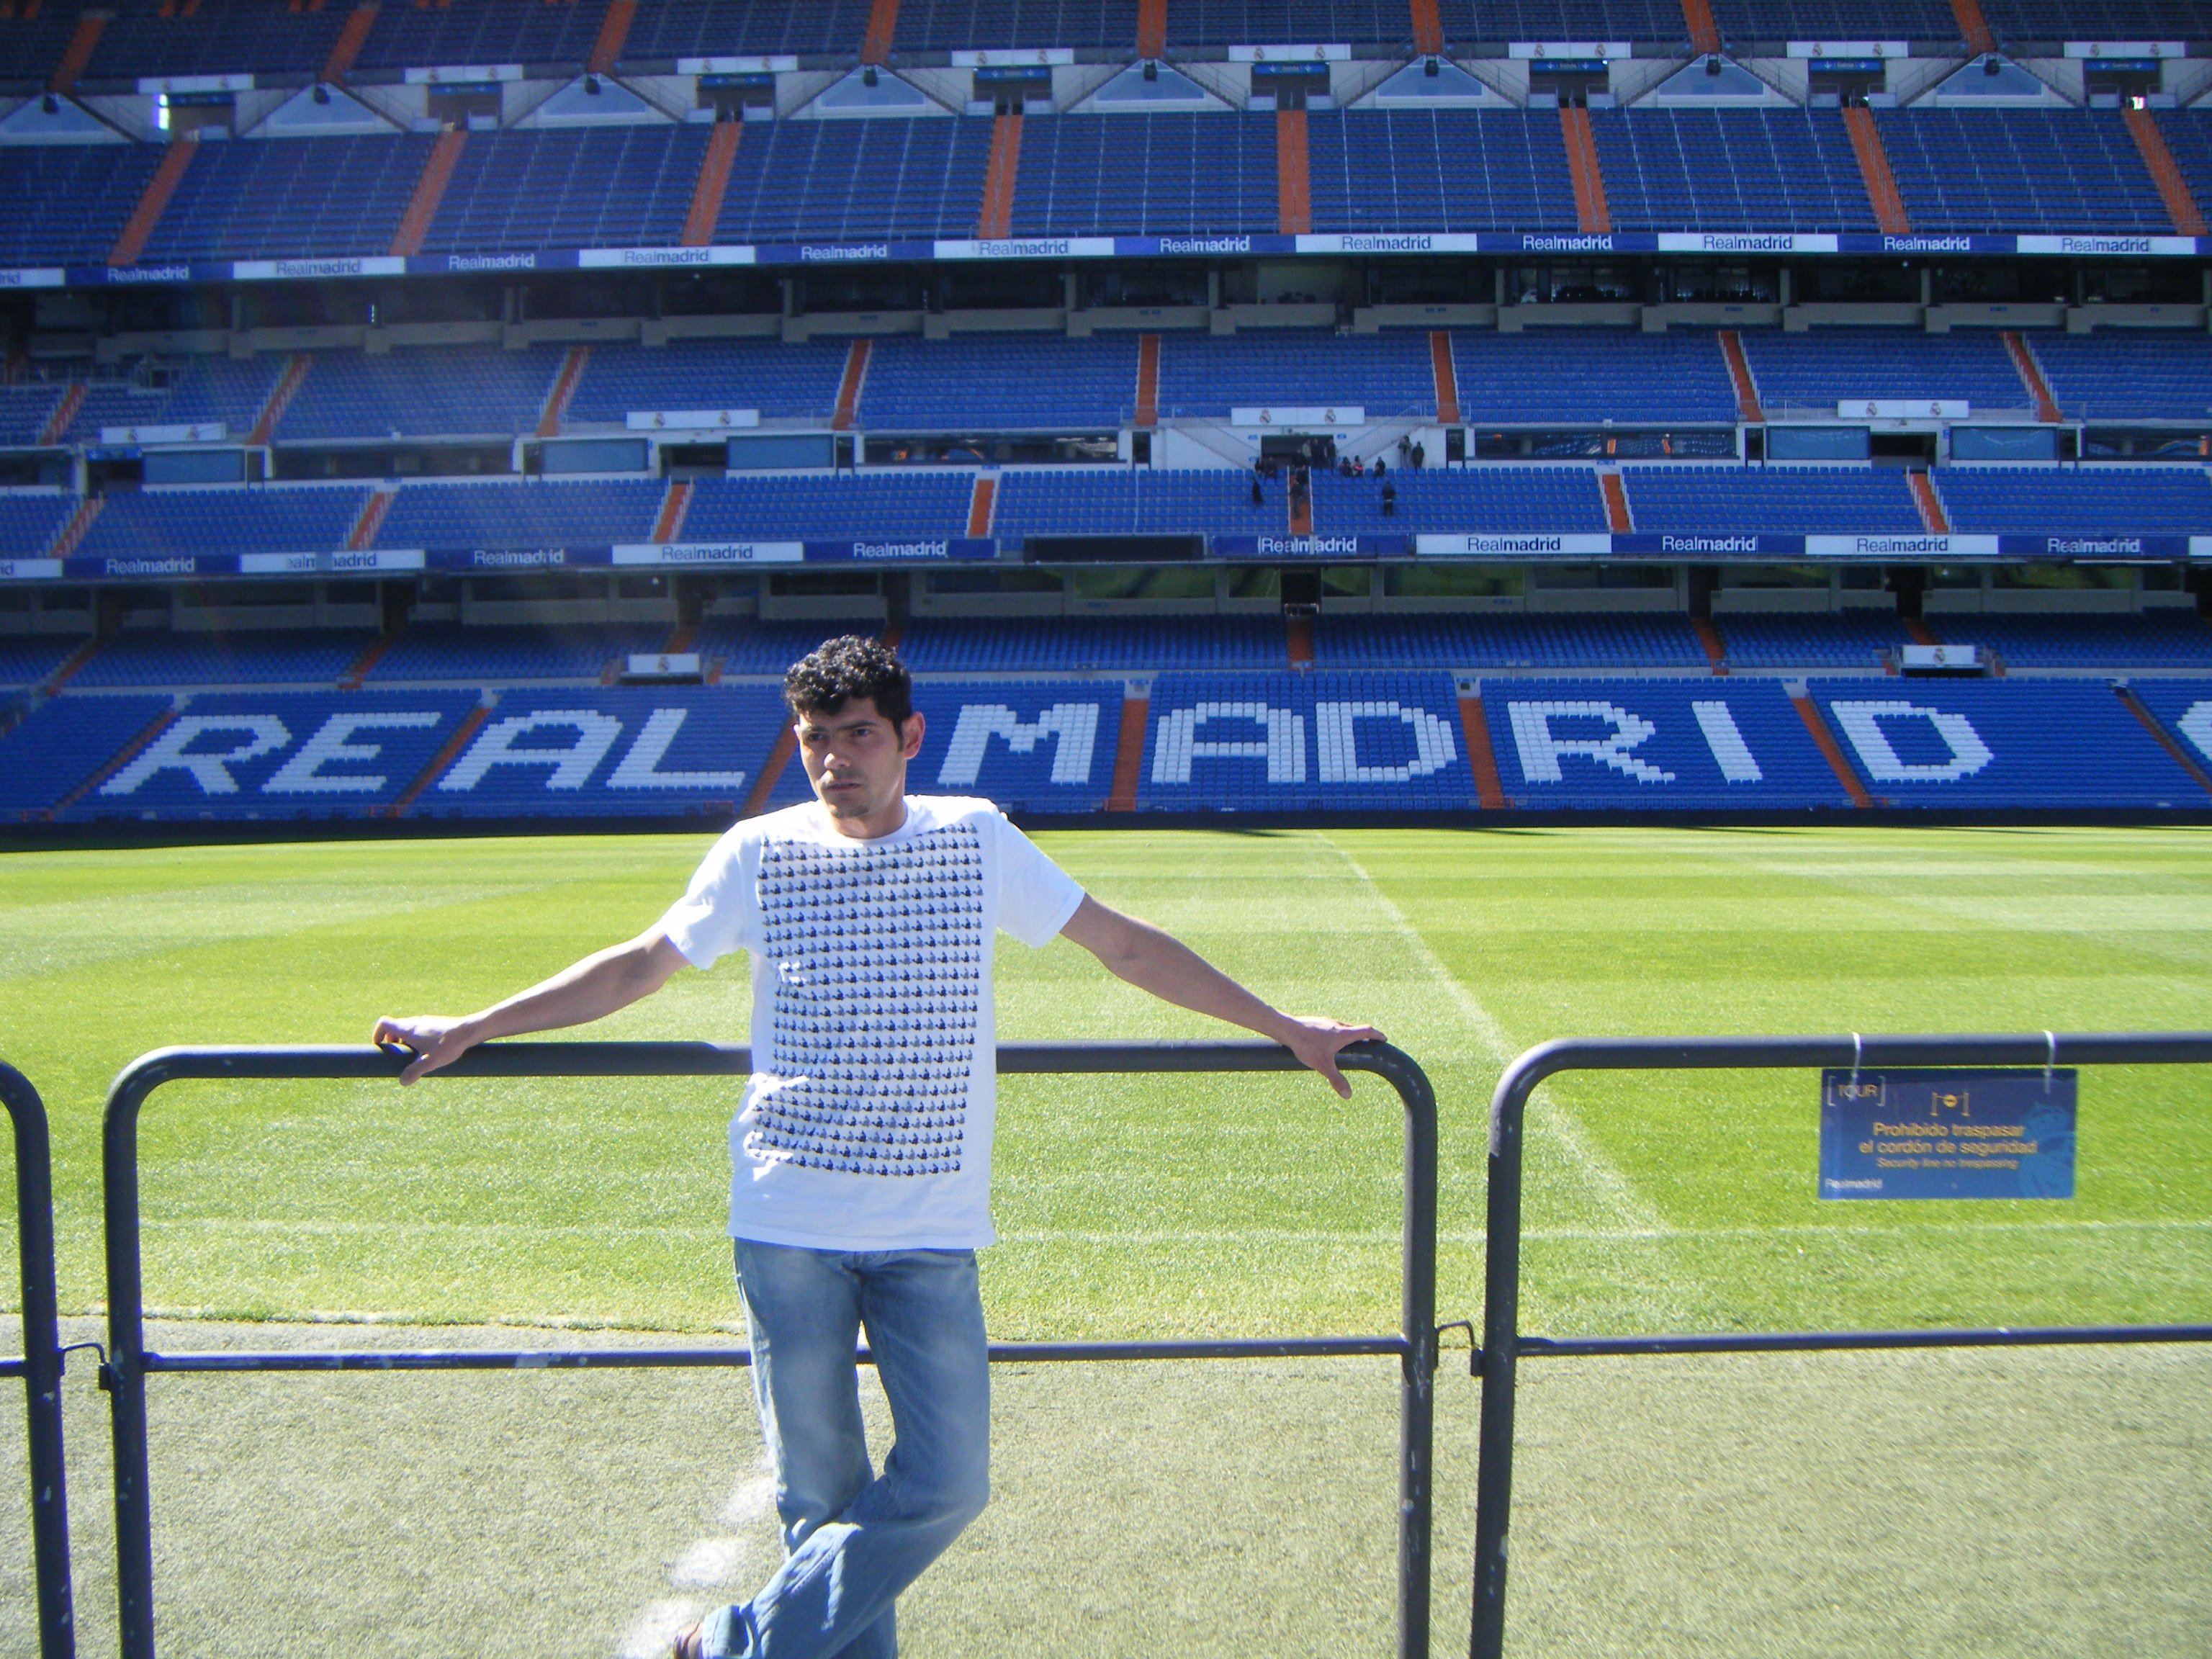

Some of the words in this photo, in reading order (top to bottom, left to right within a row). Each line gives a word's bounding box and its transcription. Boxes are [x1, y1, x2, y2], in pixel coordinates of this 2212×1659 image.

[979, 240, 1068, 256] Realmadrid
[1161, 235, 1250, 252] Realmadrid
[1342, 235, 1431, 250] Realmadrid
[1523, 235, 1613, 251] Realmadrid
[1704, 235, 1792, 251] Realmadrid
[1884, 236, 1969, 251] Realmadrid
[2062, 238, 2149, 253] Realmadrid
[624, 248, 709, 263] Realmadrid
[801, 244, 887, 259] Realmadrid
[276, 258, 361, 274] Realmadrid
[449, 253, 534, 269] Realmadrid
[108, 266, 189, 282] Realmadrid
[854, 541, 946, 557] Realmadrid
[1467, 536, 1561, 552] Realmadrid
[1663, 536, 1755, 552] Realmadrid
[1856, 537, 1948, 553] Realmadrid
[475, 549, 564, 565] Realmadrid
[662, 545, 753, 560] Realmadrid
[106, 557, 194, 574] Realmadrid
[99, 708, 745, 796] REAL
[937, 701, 1995, 787] MADRID
[1873, 1122, 1948, 1138] Prohibido
[1951, 1123, 2026, 1139] traspasar
[1858, 1140, 1874, 1154] el
[1876, 1140, 1933, 1154] cordón
[1936, 1140, 1957, 1154] de
[1959, 1139, 2038, 1156] seguridad
